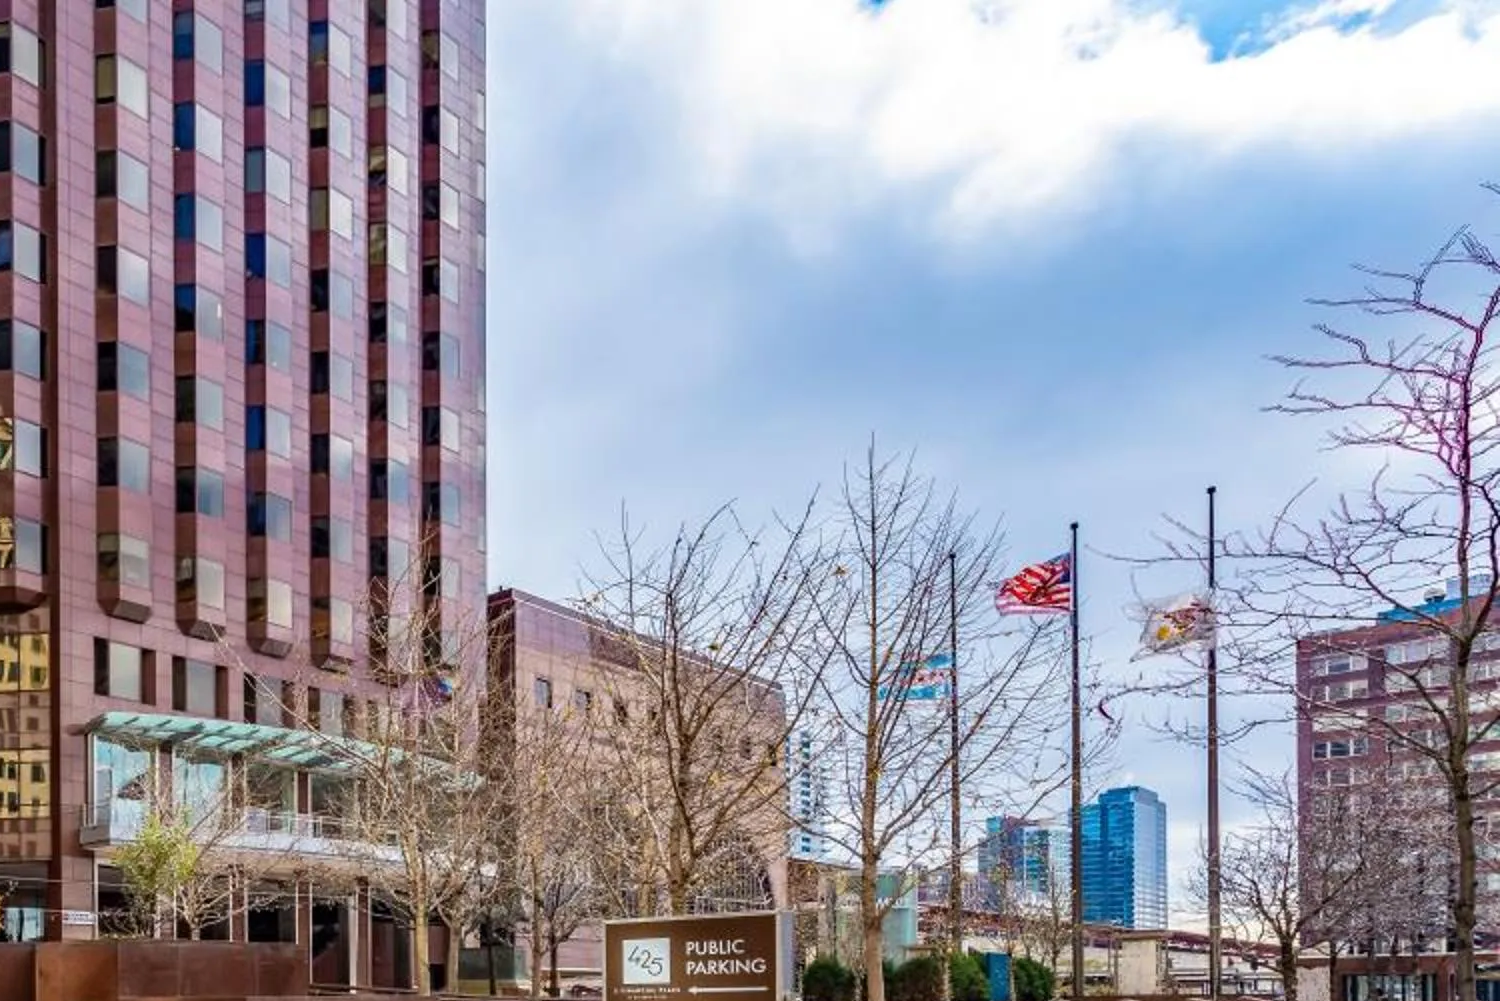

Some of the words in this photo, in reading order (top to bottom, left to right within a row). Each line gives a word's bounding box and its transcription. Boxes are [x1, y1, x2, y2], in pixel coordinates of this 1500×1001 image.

[685, 939, 745, 956] PUBLIC
[627, 945, 664, 977] 425
[685, 957, 767, 976] PARKING
